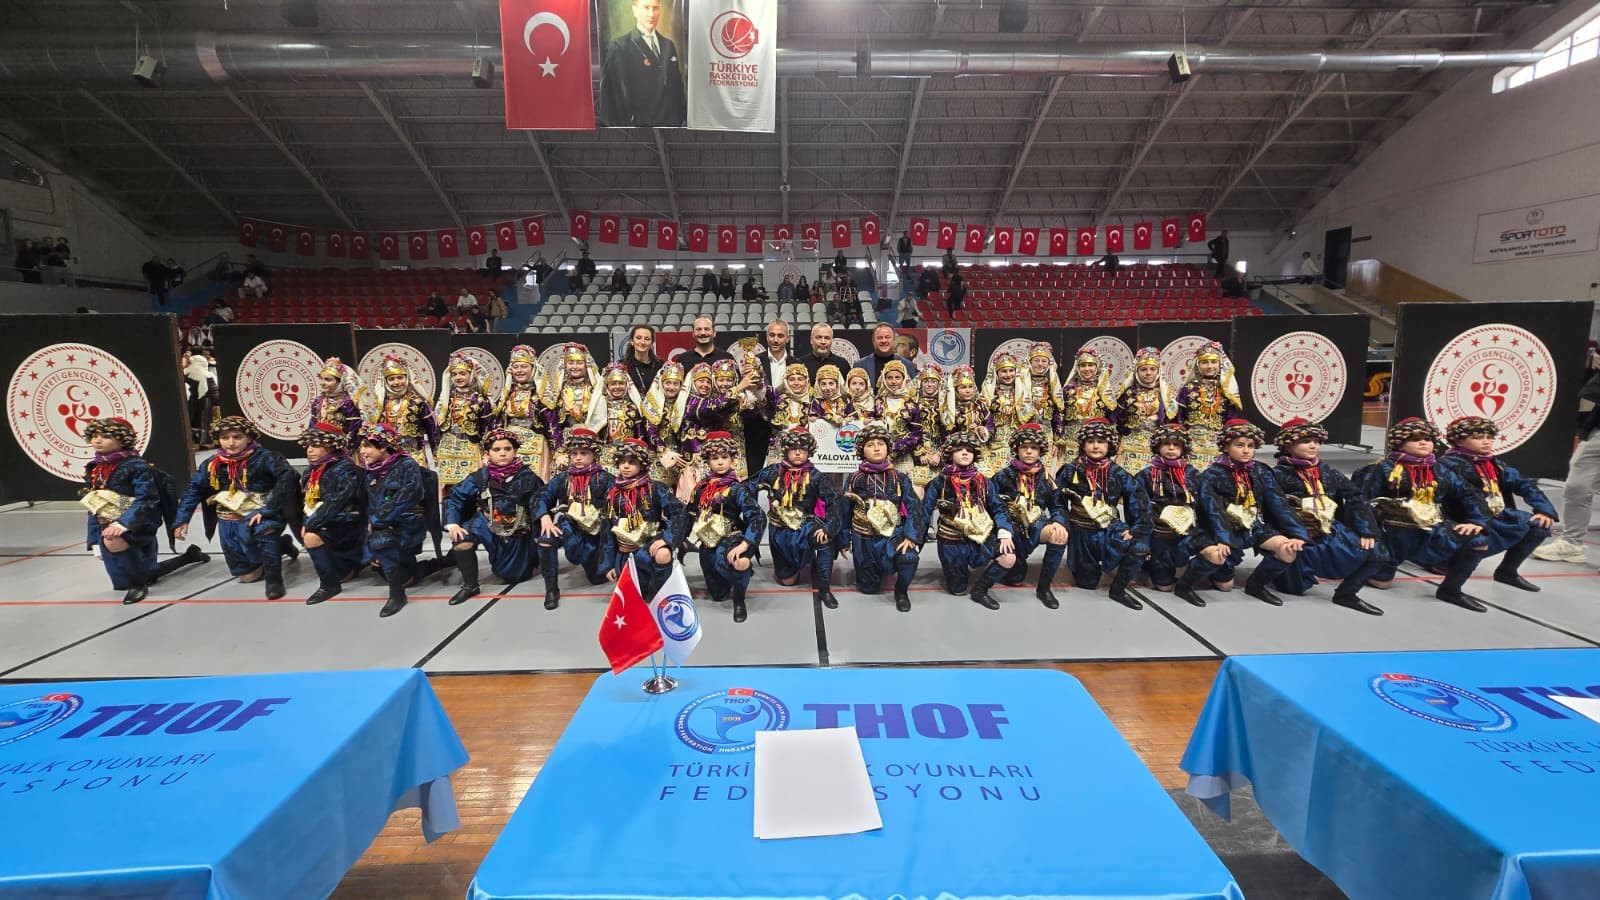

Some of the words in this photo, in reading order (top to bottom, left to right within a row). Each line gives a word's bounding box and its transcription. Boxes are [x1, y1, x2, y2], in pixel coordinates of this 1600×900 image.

[709, 60, 758, 74] TÜRKİYE
[709, 72, 758, 81] BASKETBOL
[709, 80, 758, 88] FEDERASYONU
[1482, 350, 1515, 363] GENÇLİK
[1515, 360, 1524, 370] VE
[1520, 370, 1530, 392] SPOR
[62, 371, 99, 383] GENÇLİK
[100, 379, 110, 392] VE
[109, 392, 123, 414] SPOR
[57, 698, 292, 739] THOF
[803, 703, 1010, 740] THOF
[1464, 739, 1593, 753] TÜRKİYE
[67, 753, 216, 772] OYUNLARI
[669, 761, 749, 778] TÜRKİ
[885, 762, 1034, 779] OYUNLARI
